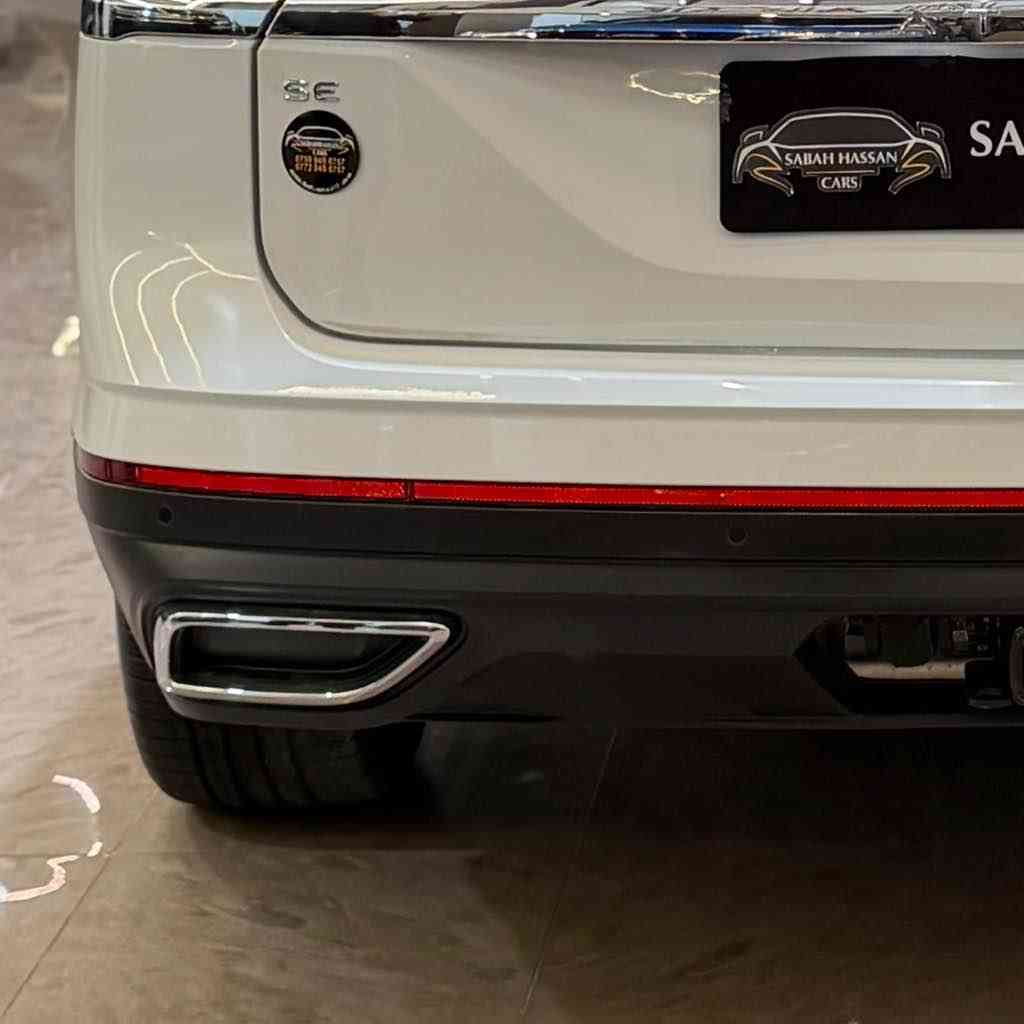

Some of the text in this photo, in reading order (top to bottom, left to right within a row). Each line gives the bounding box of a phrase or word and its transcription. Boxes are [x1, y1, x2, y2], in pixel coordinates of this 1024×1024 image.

[284, 80, 340, 102] SE
[784, 151, 898, 166] SABAH HASSAN
[820, 176, 858, 189] CARS
